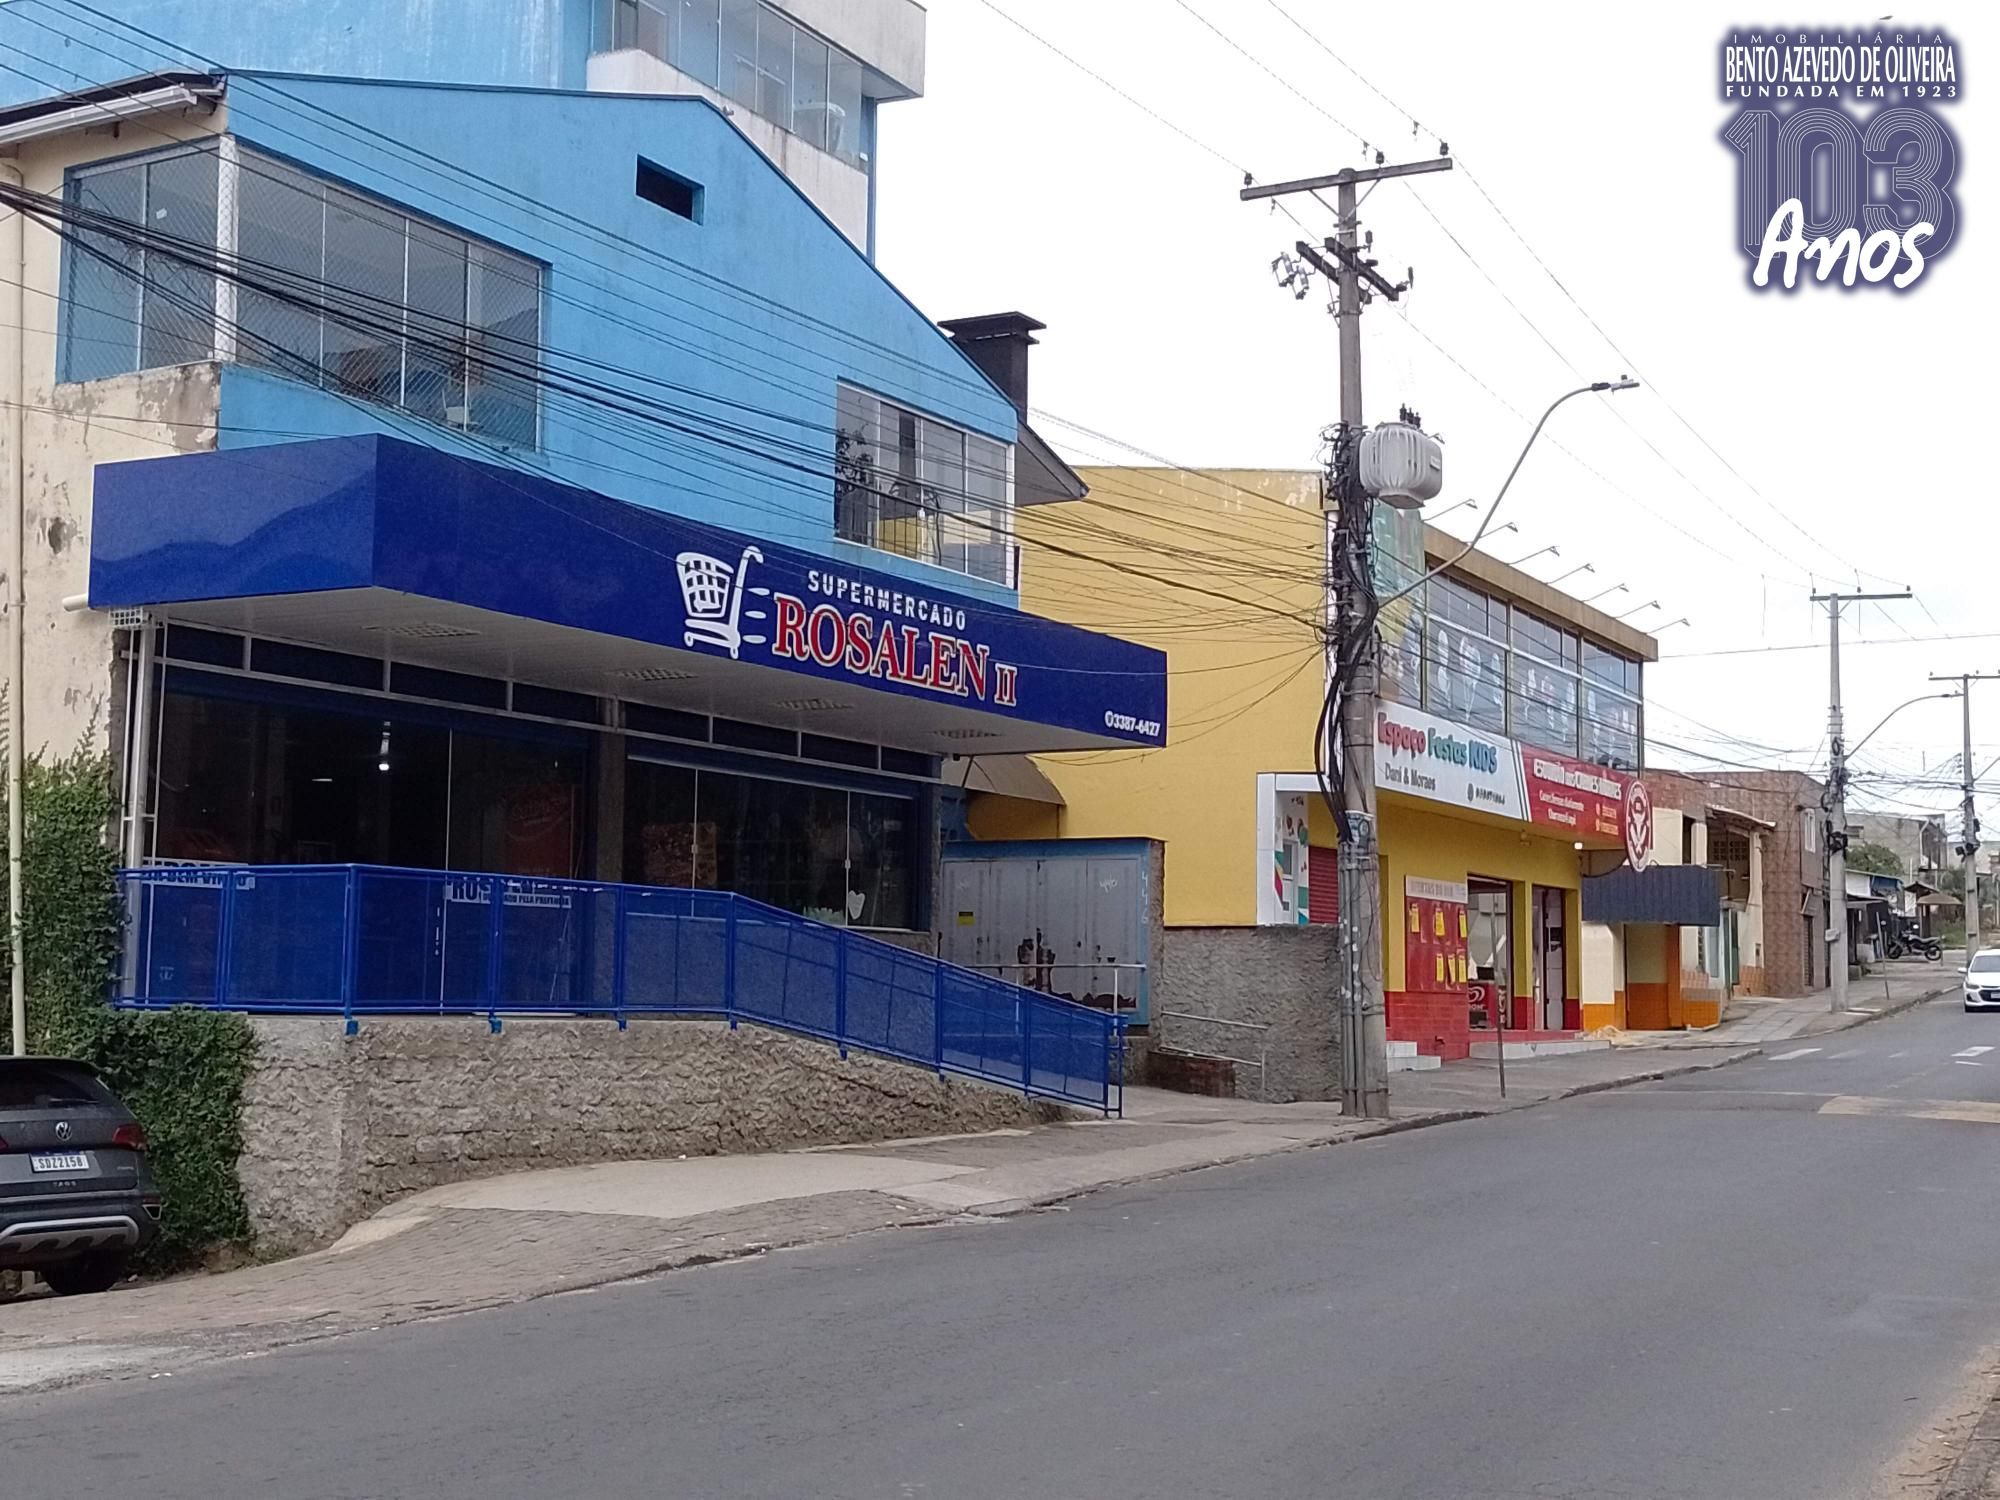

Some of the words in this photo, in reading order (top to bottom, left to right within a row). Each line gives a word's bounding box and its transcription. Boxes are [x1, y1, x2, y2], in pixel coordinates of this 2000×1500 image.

[808, 570, 966, 631] SUPERMERCADO
[772, 591, 989, 700] ROSALEN
[995, 662, 1017, 707] II
[1468, 740, 1498, 774] KIDS
